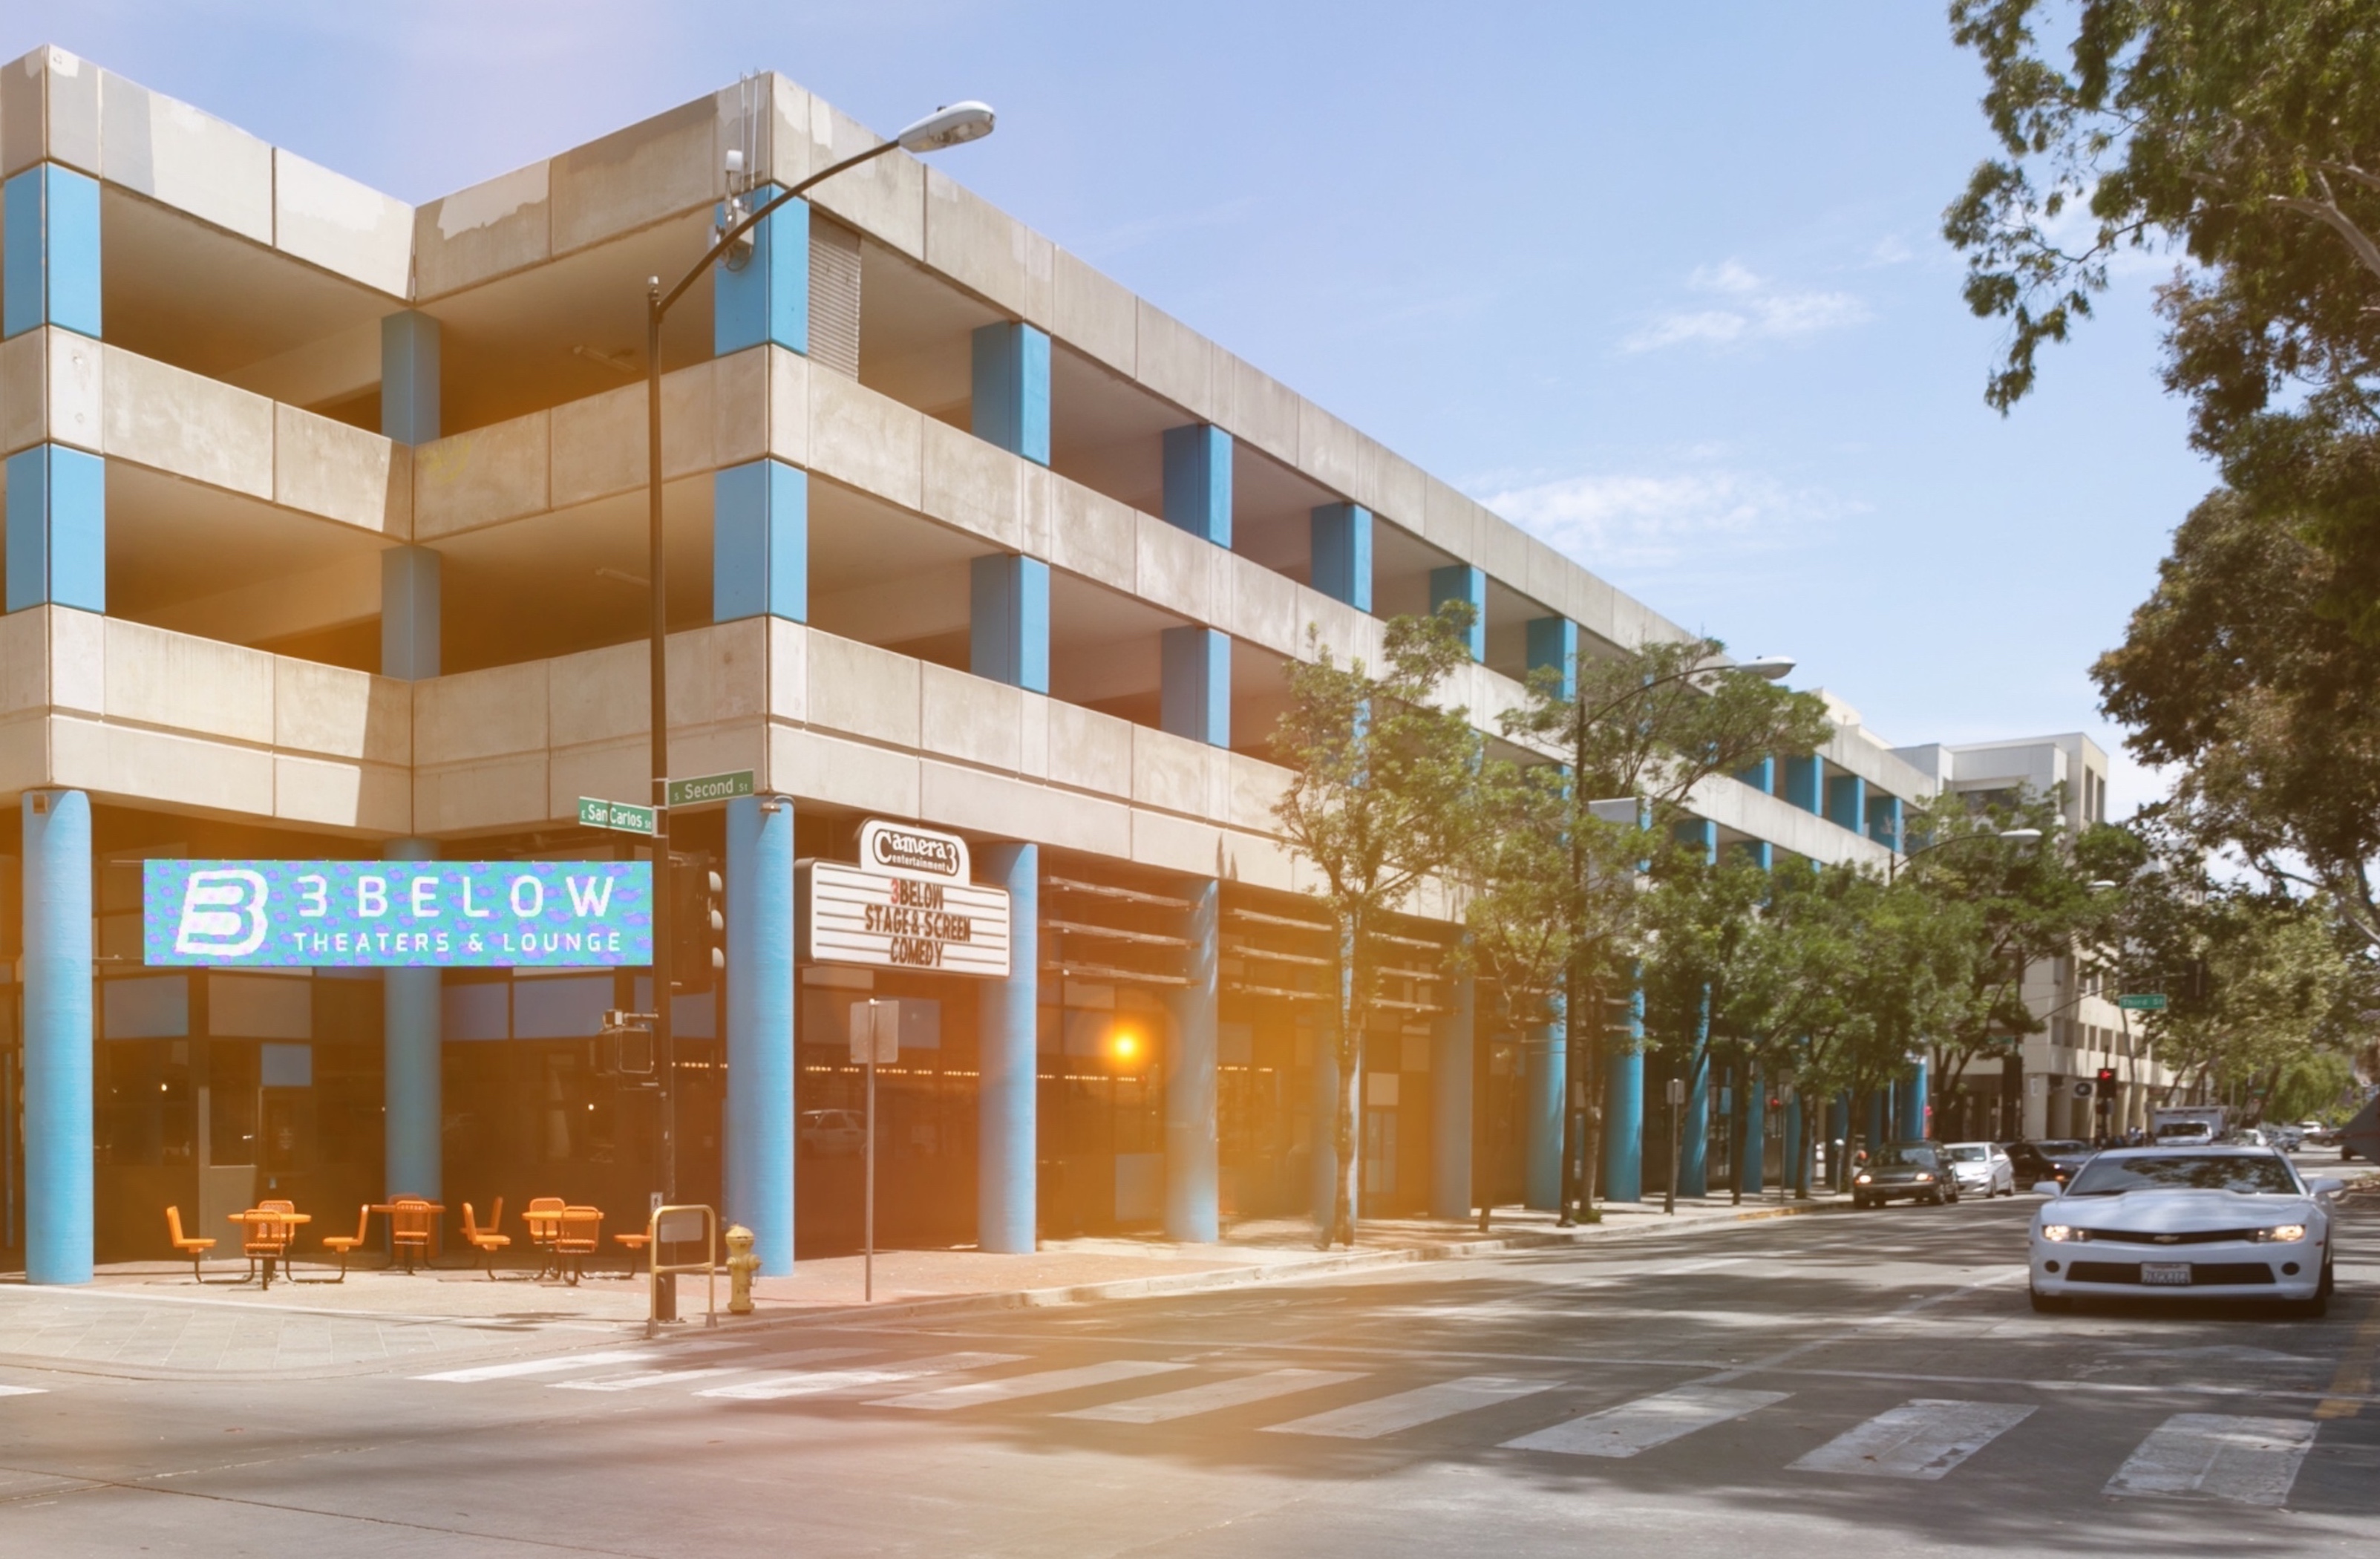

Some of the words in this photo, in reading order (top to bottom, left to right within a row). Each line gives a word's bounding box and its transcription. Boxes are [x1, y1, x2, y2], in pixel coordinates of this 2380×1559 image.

[674, 792, 679, 801] S
[684, 778, 733, 800] Second
[739, 783, 748, 792] St
[581, 809, 585, 820] E
[587, 803, 608, 823] San
[609, 807, 643, 828] Carlos
[644, 821, 652, 830] St
[874, 831, 947, 863] Camera
[892, 854, 946, 872] entertainment
[298, 875, 327, 917] 3
[358, 876, 615, 917] BELOW
[923, 911, 971, 942] SCREEN
[294, 932, 449, 952] THEATERS
[468, 933, 483, 952] &
[503, 932, 621, 952] LOUNGE
[891, 936, 944, 967] COMEDY
[2122, 998, 2148, 1007] Third
[2153, 997, 2164, 1006] St
